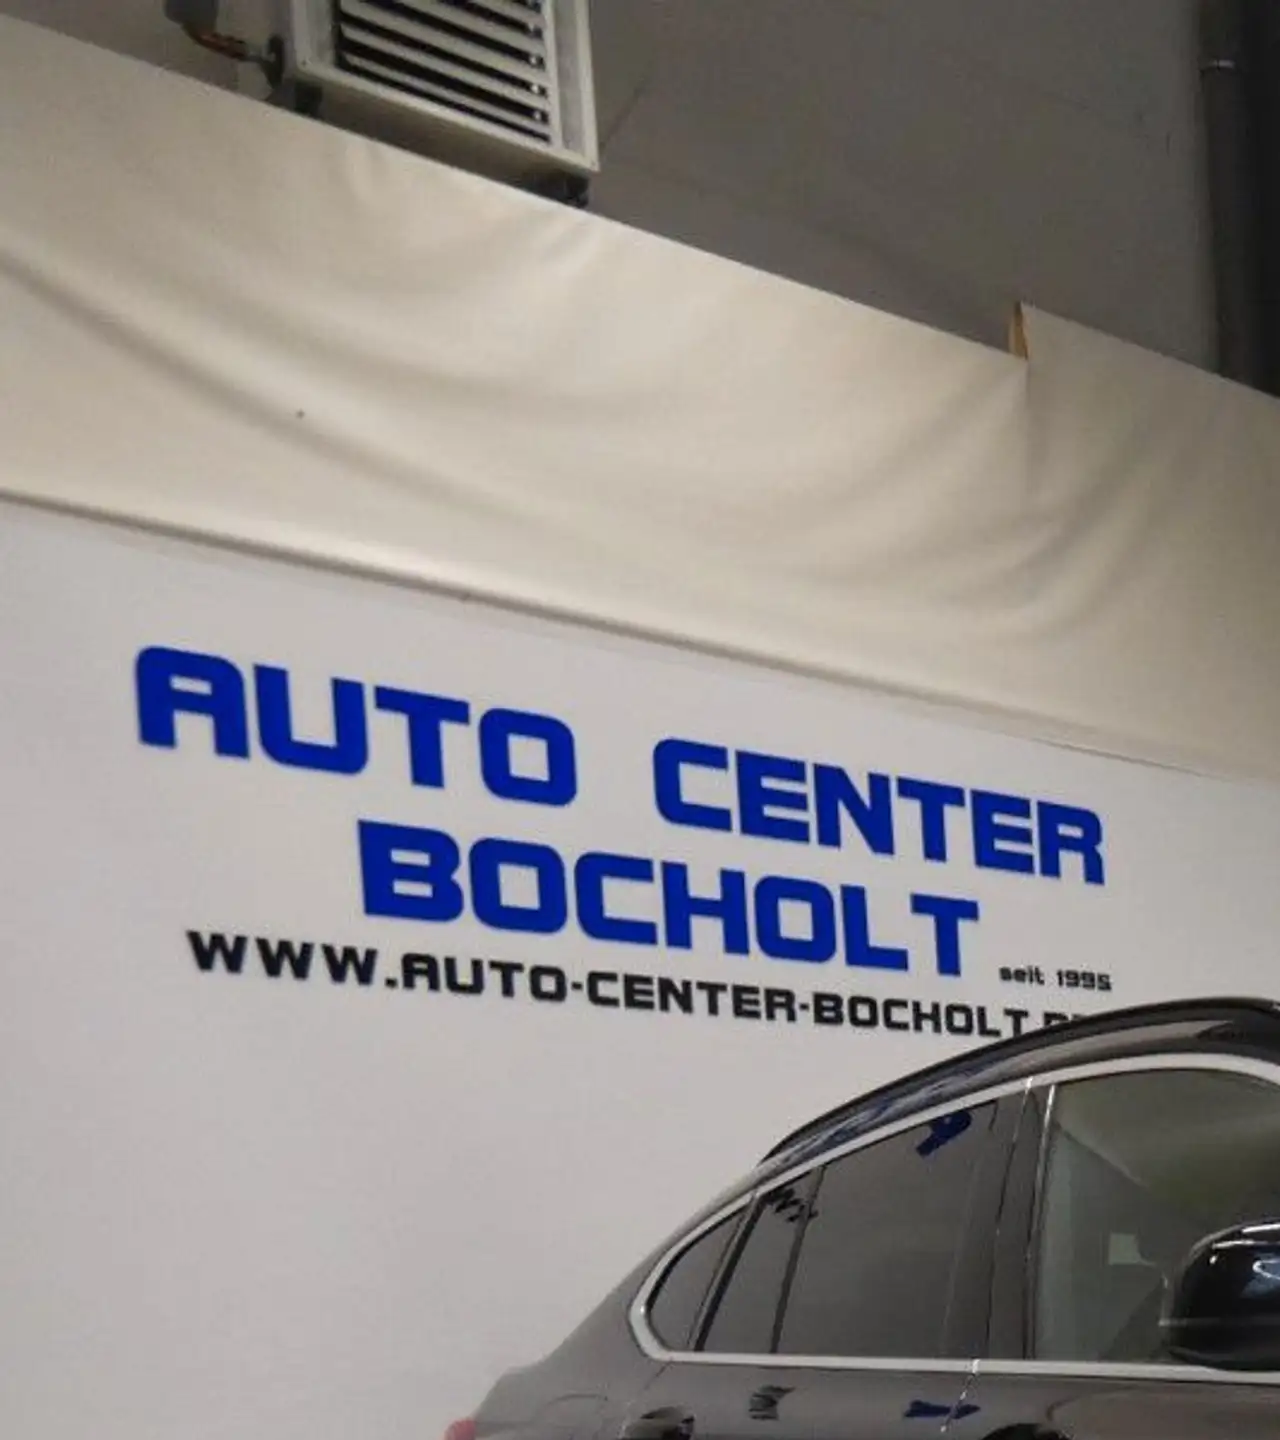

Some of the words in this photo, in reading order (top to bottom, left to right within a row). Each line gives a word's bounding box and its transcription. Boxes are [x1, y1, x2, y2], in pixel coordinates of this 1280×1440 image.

[136, 645, 578, 809] AUTO
[652, 737, 1107, 885] CENTER
[358, 819, 980, 977] BOCHOLT
[186, 929, 1087, 1038] WWW.AUTO-CENTER-BOCHOLT
[998, 965, 1046, 985] seit
[1055, 969, 1113, 992] 1995
